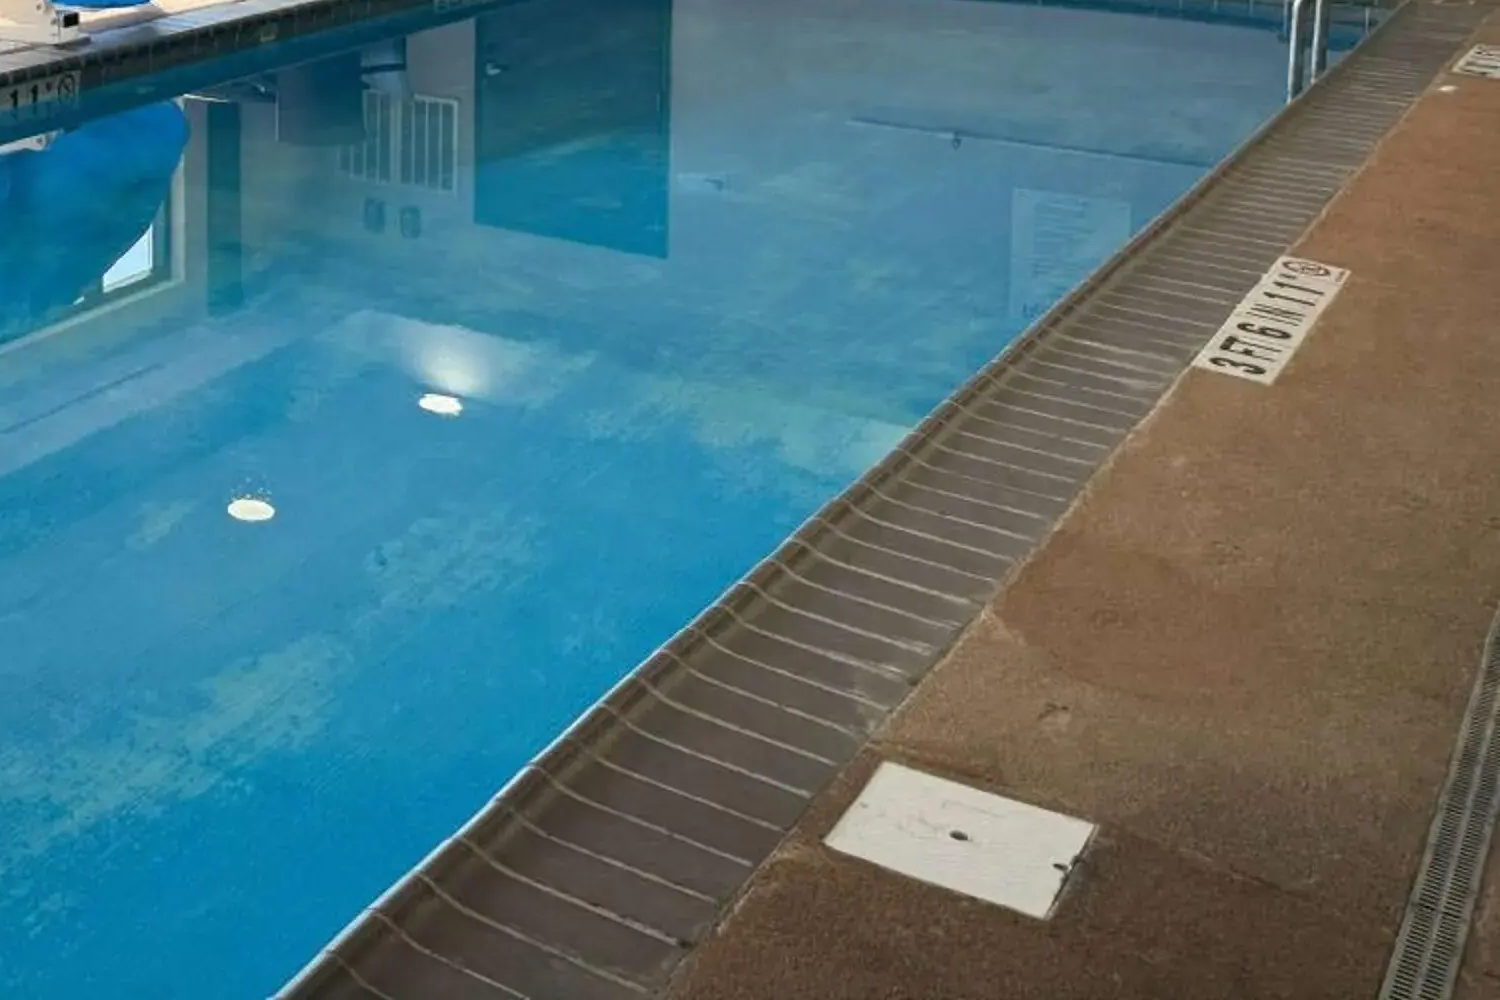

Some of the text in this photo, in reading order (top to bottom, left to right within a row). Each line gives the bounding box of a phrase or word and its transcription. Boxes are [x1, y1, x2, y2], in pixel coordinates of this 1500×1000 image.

[1245, 303, 1307, 327] IN
[1237, 322, 1293, 340] 6
[1219, 335, 1283, 364] FT
[1209, 357, 1266, 375] 3
